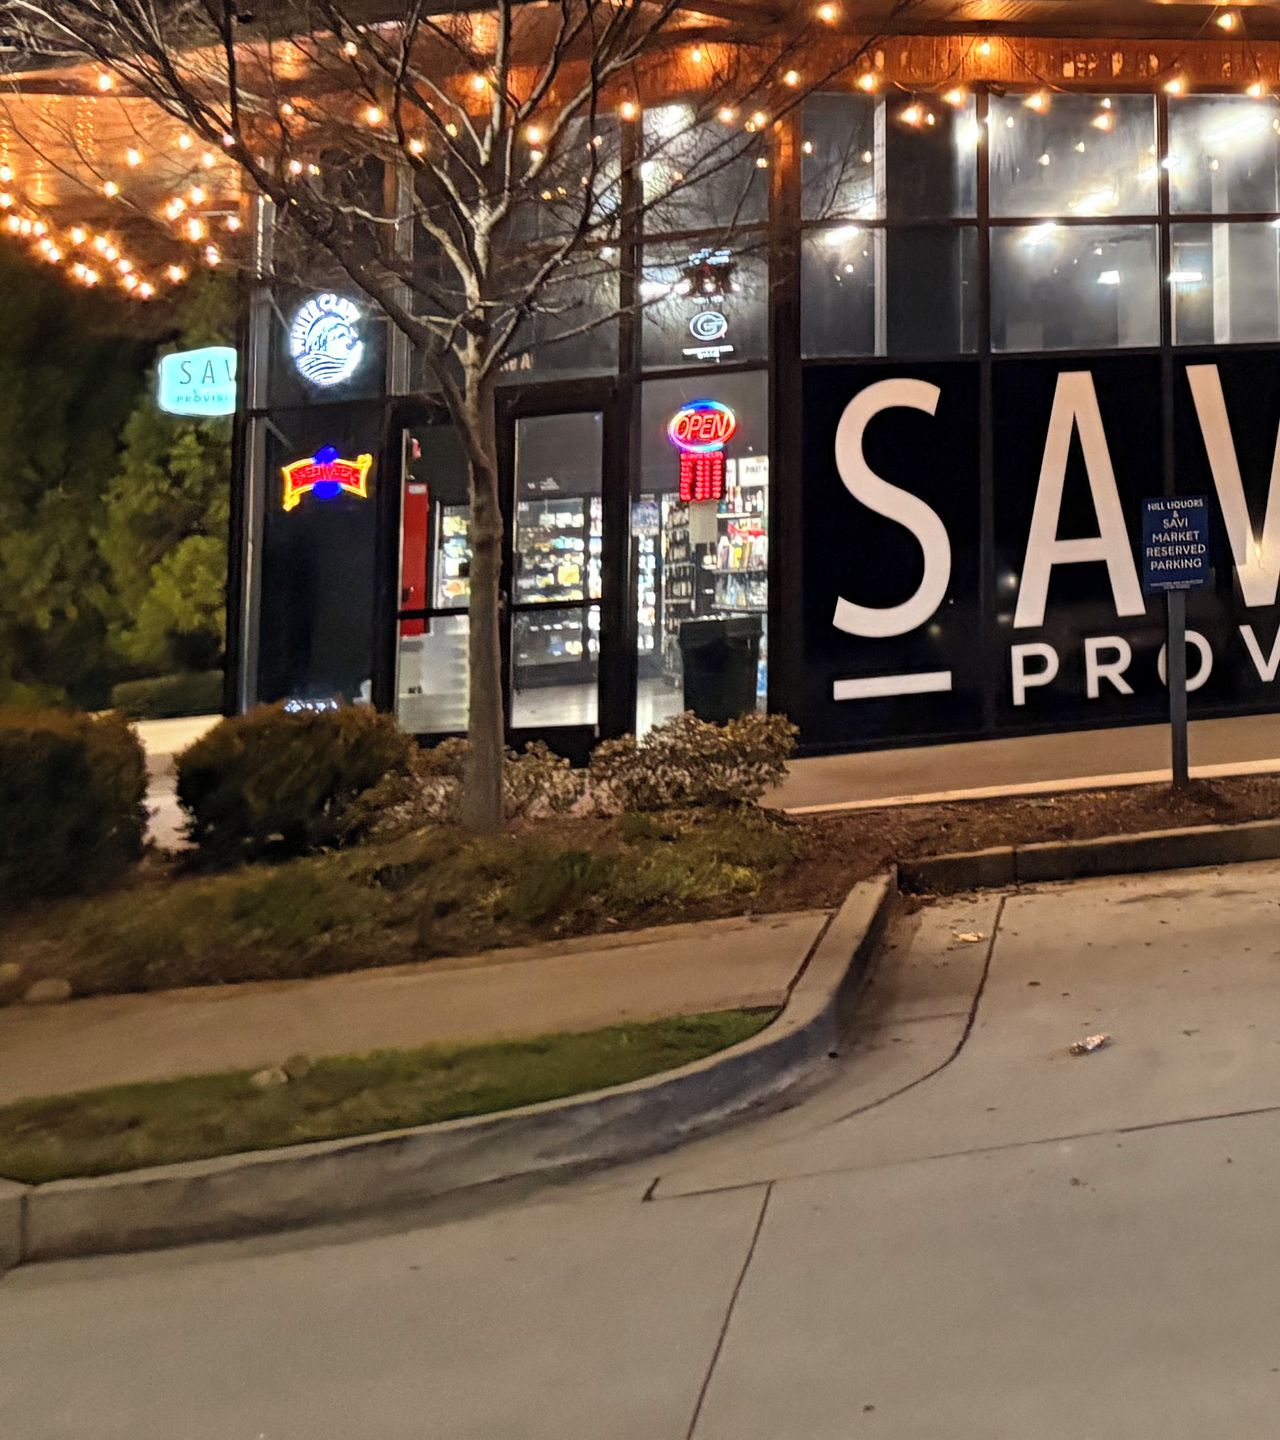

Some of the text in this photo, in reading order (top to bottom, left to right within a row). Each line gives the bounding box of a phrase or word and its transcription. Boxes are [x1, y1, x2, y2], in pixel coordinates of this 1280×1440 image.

[676, 414, 730, 440] OPEN
[1148, 499, 1203, 511] HILL LIQUORS
[1163, 517, 1188, 529] SAVI
[1152, 531, 1200, 543] MARKET
[1146, 544, 1206, 558] RESERVED
[1150, 558, 1202, 571] PARKING
